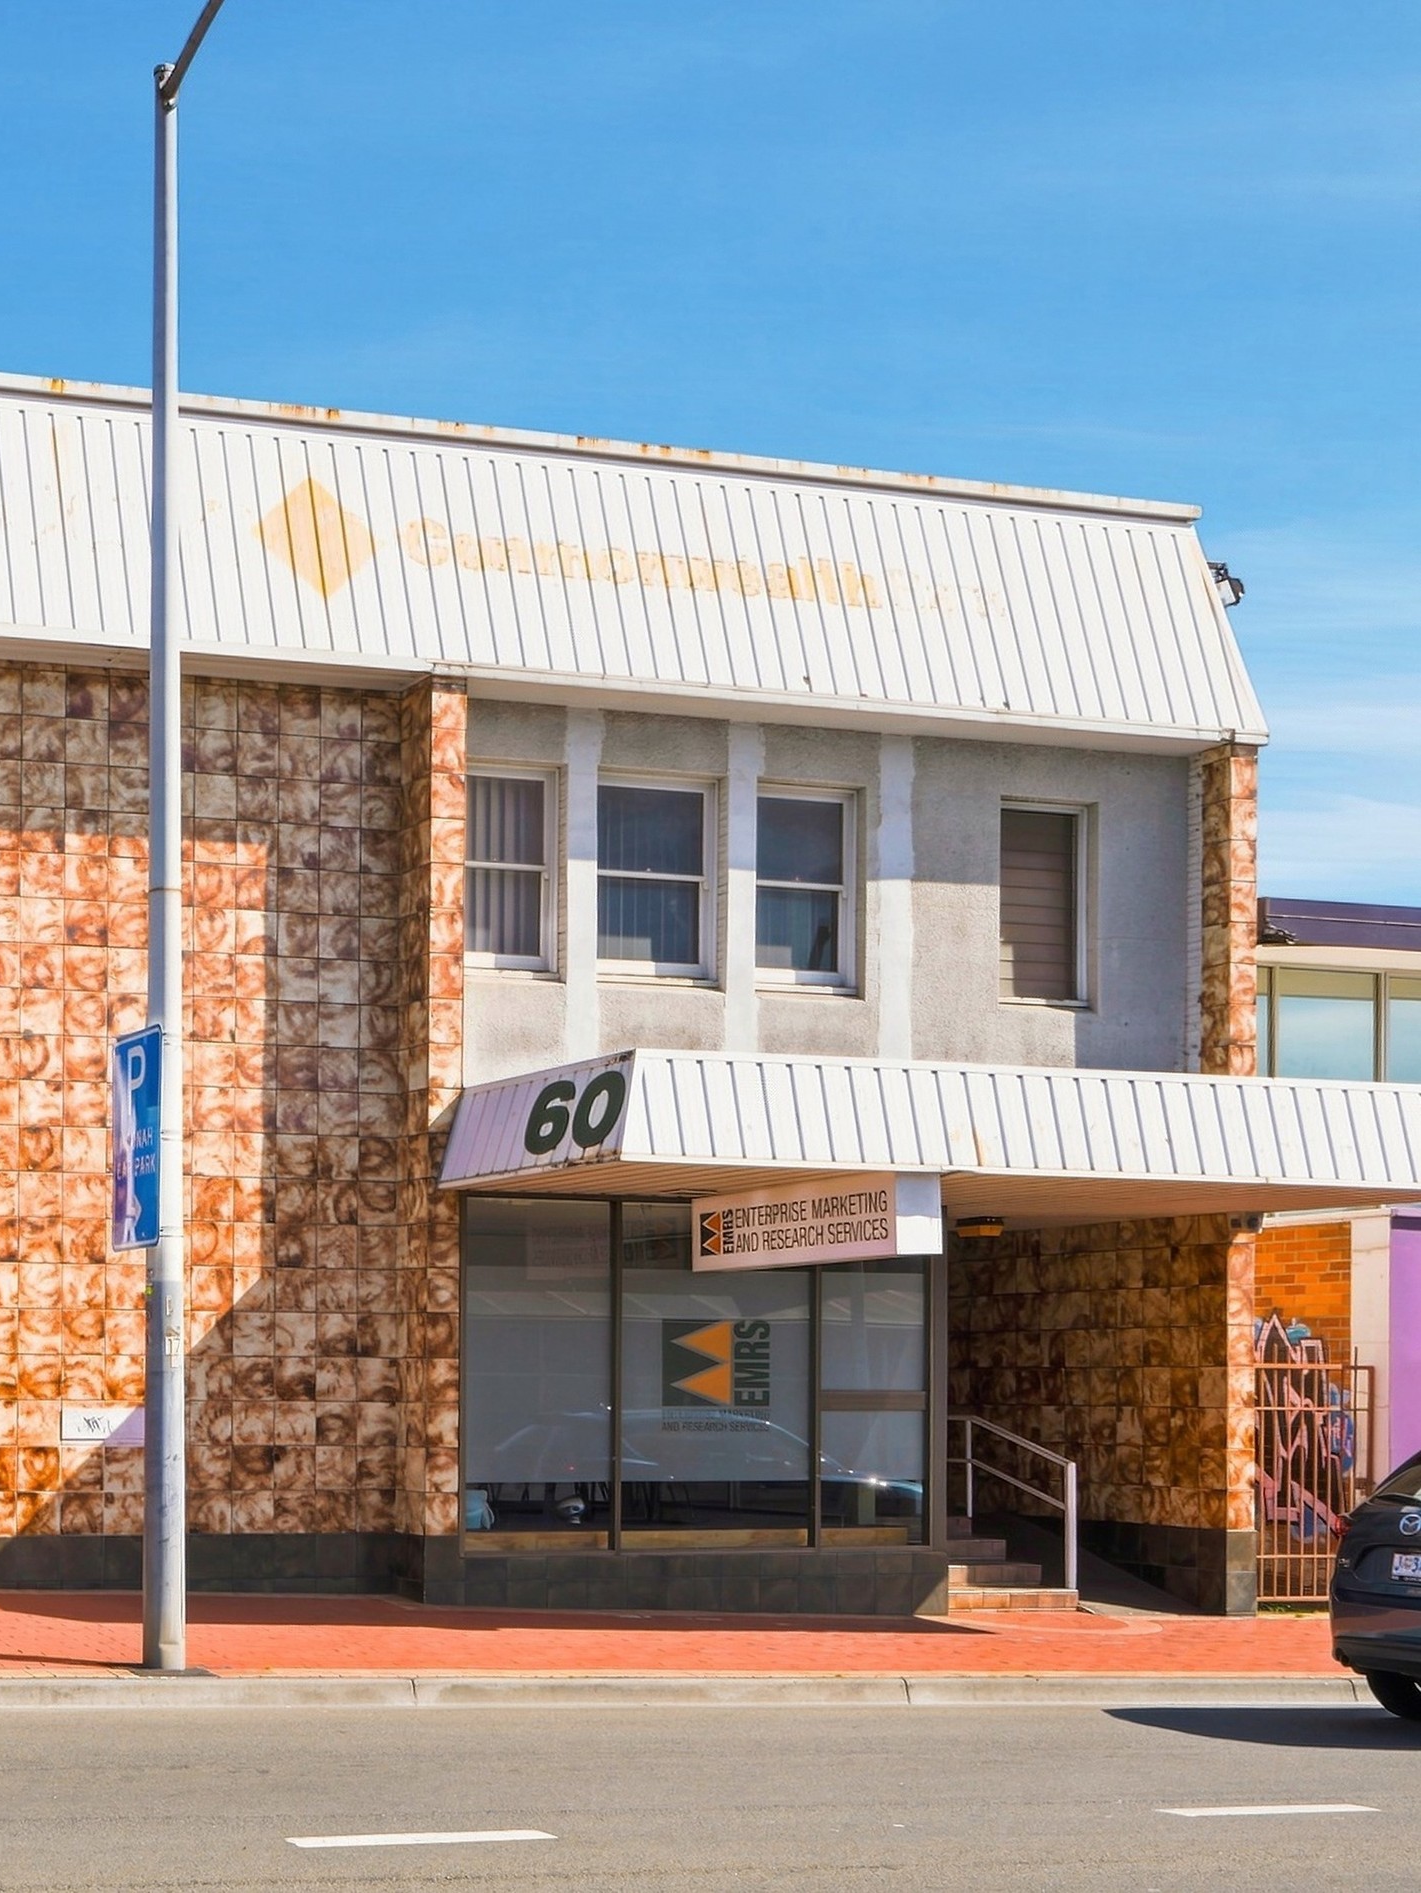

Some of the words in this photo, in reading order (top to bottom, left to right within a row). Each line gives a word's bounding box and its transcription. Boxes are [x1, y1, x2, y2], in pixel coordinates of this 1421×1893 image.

[127, 1045, 147, 1117] P
[524, 1070, 626, 1155] 60
[134, 1153, 156, 1177] PARK
[735, 1200, 808, 1229] ENTERPRISE
[811, 1190, 888, 1219] MARKETING
[722, 1208, 735, 1255] EMRS
[736, 1231, 759, 1254] AND
[763, 1224, 824, 1251] RESEARCH
[827, 1217, 888, 1245] SERVICES
[733, 1319, 770, 1407] EMRS
[662, 1421, 680, 1433] AND
[683, 1421, 728, 1433] RESEARCH
